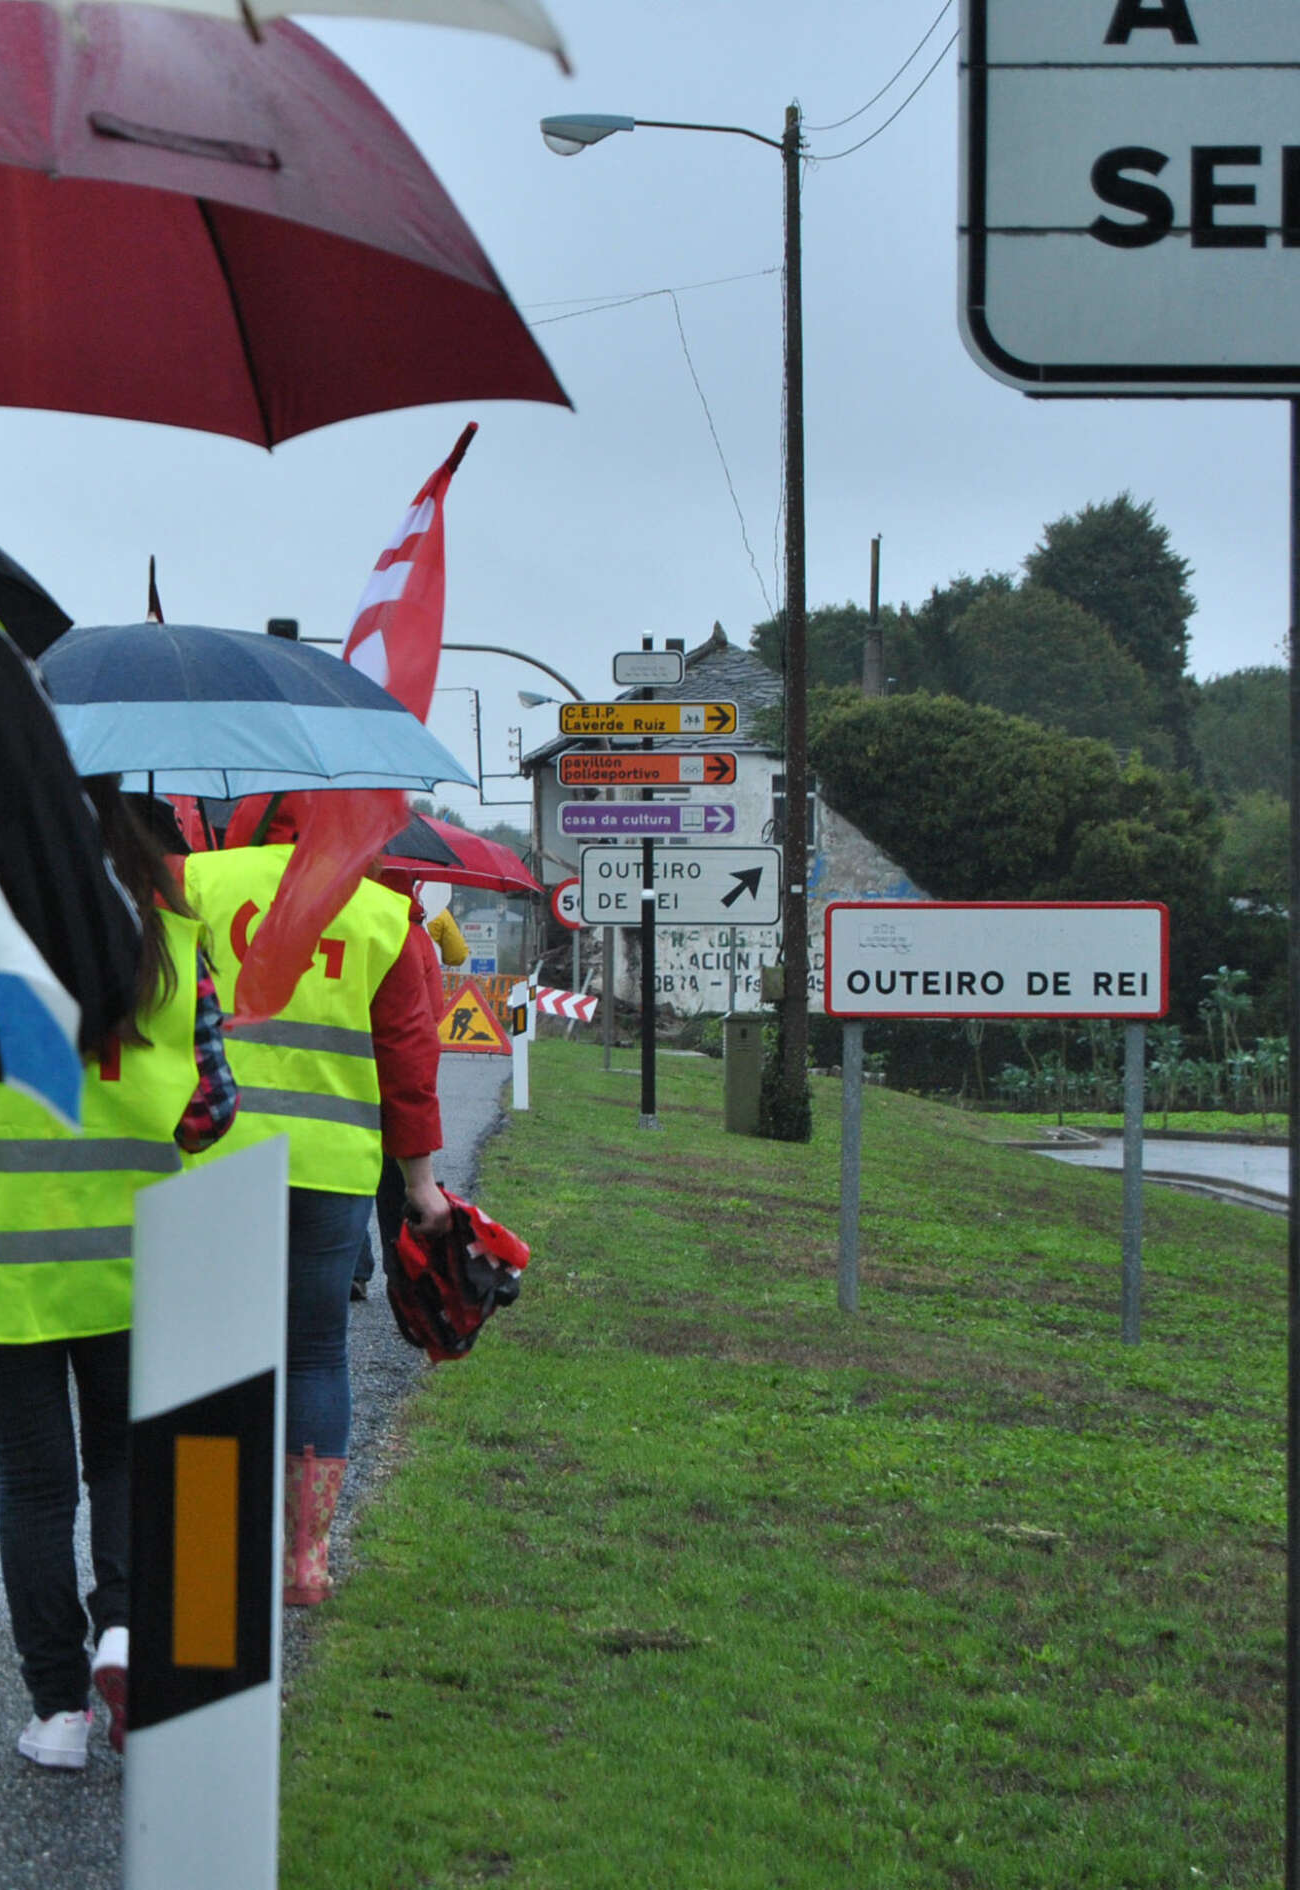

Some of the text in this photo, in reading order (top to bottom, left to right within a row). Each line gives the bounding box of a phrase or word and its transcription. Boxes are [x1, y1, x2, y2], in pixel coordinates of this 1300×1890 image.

[1090, 145, 1300, 249] SE
[564, 706, 620, 718] C.E.I.P.
[564, 719, 625, 731] Laverde
[564, 768, 660, 781] polideportivo
[564, 814, 672, 825] casa da cultura
[562, 895, 580, 911] 5
[598, 893, 628, 909] DE
[846, 969, 1148, 997] OUTEIRO DE REI
